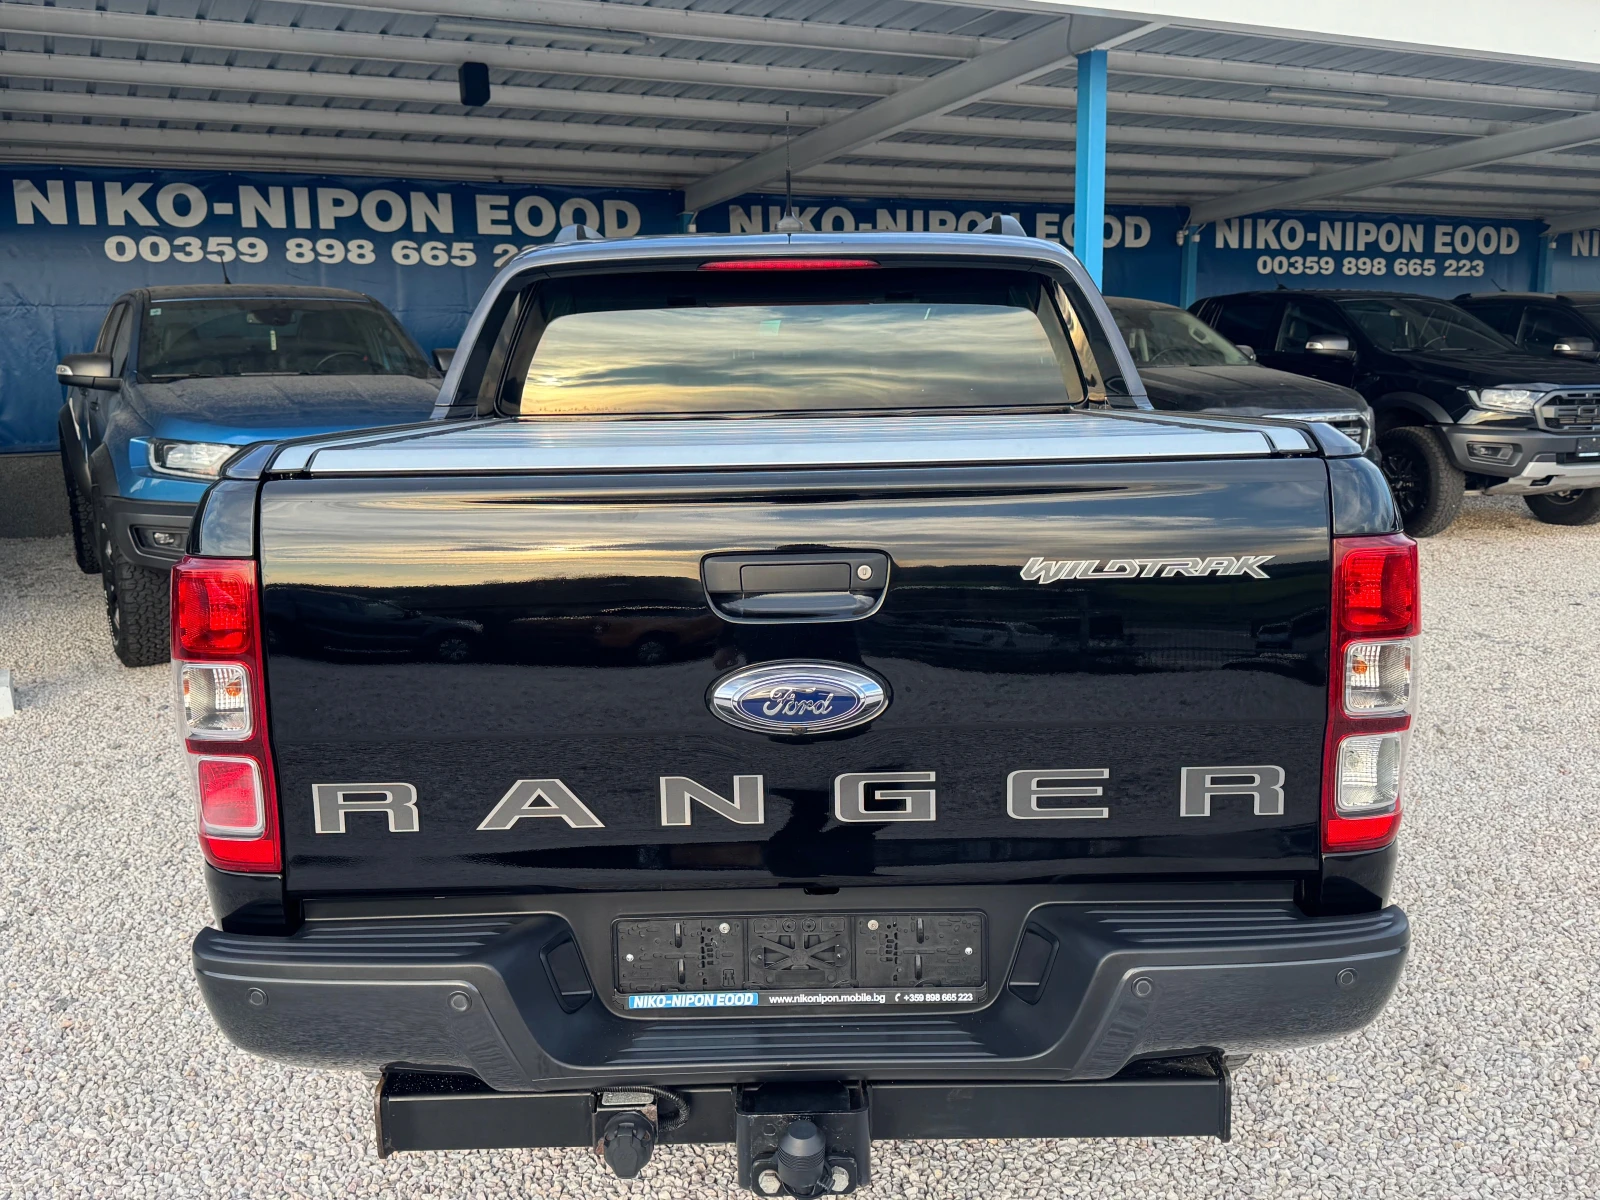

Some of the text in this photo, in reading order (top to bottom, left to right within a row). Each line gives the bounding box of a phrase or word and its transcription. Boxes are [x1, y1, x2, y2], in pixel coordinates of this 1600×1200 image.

[12, 178, 642, 238] NIKO-NIPON EOOD
[1215, 217, 1520, 255] NIKO-NIPON EOOD
[104, 235, 269, 263] 00359
[285, 237, 376, 265] 898
[391, 240, 477, 267] 665
[1256, 255, 1485, 277] 00359 898 665 223
[1019, 555, 1277, 584] WILDTRAK
[762, 686, 835, 716] Ford
[312, 765, 1286, 834] RANGER
[633, 993, 754, 1009] NIKO-NIPON EOOD
[769, 993, 886, 1004] www.nikonipon.mobile.bg
[903, 992, 973, 1002] +359 898 665 223
